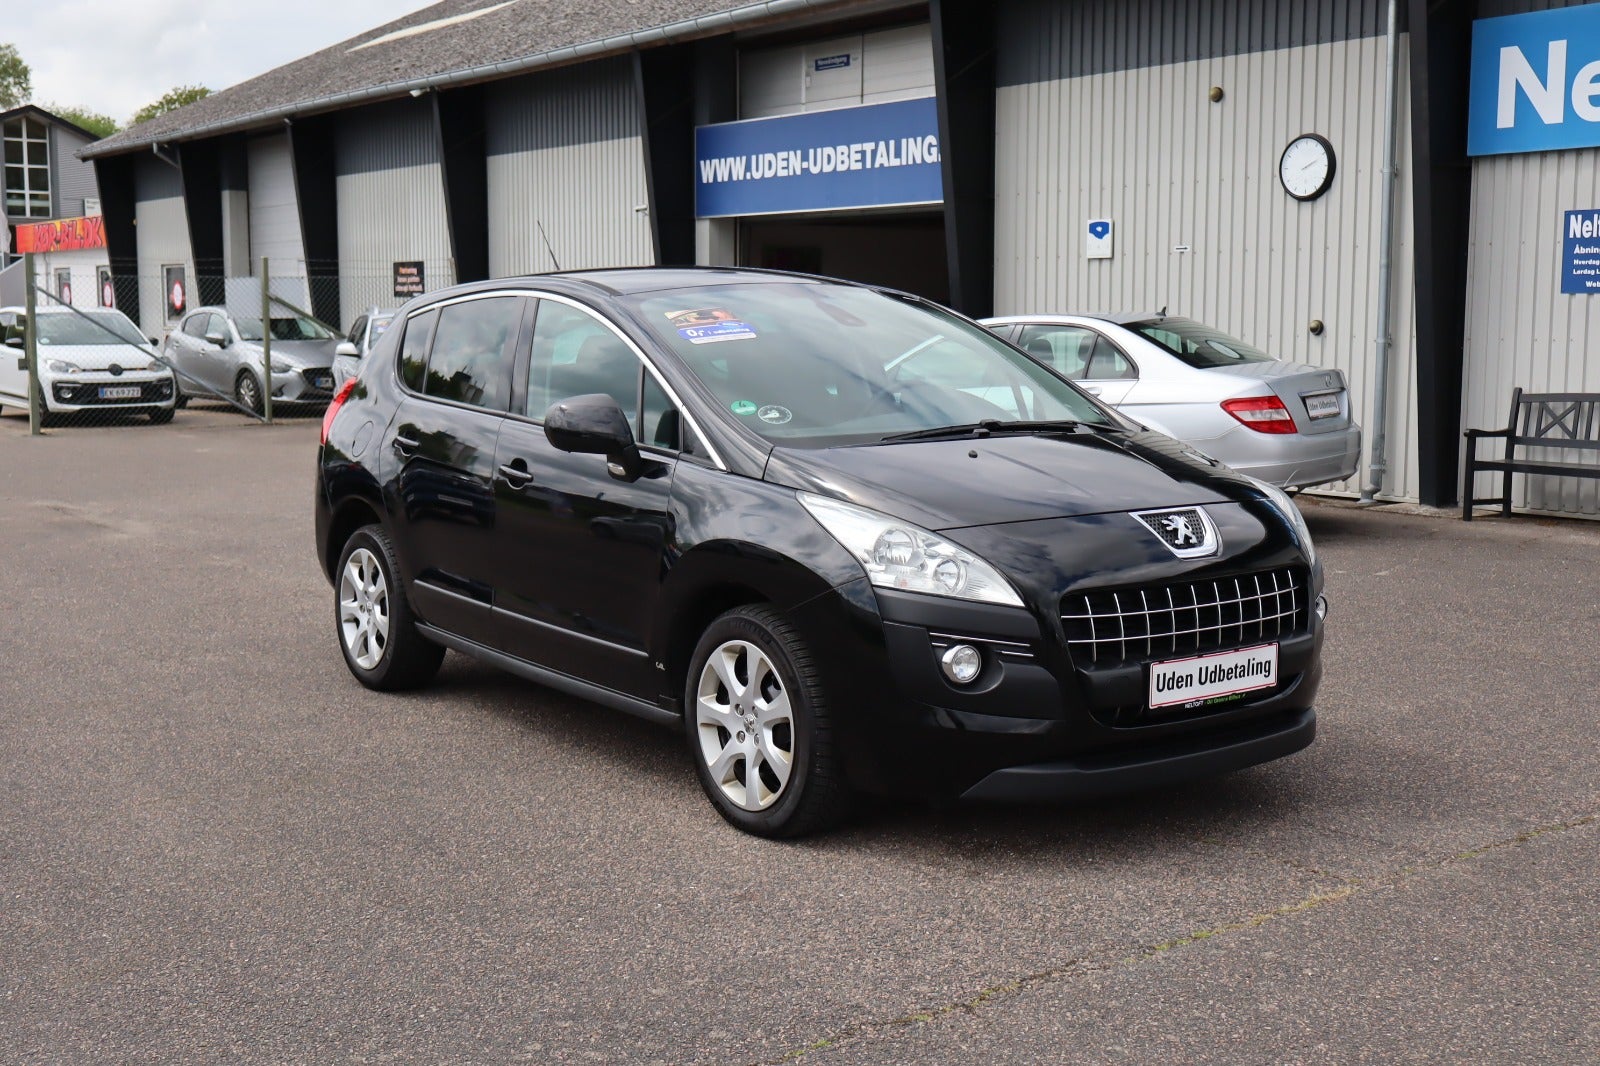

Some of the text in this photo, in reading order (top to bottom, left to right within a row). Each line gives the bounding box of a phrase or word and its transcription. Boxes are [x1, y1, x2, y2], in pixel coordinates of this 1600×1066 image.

[1573, 243, 1600, 255] Åbnin
[1156, 657, 1272, 693] Uden Udbetaling
